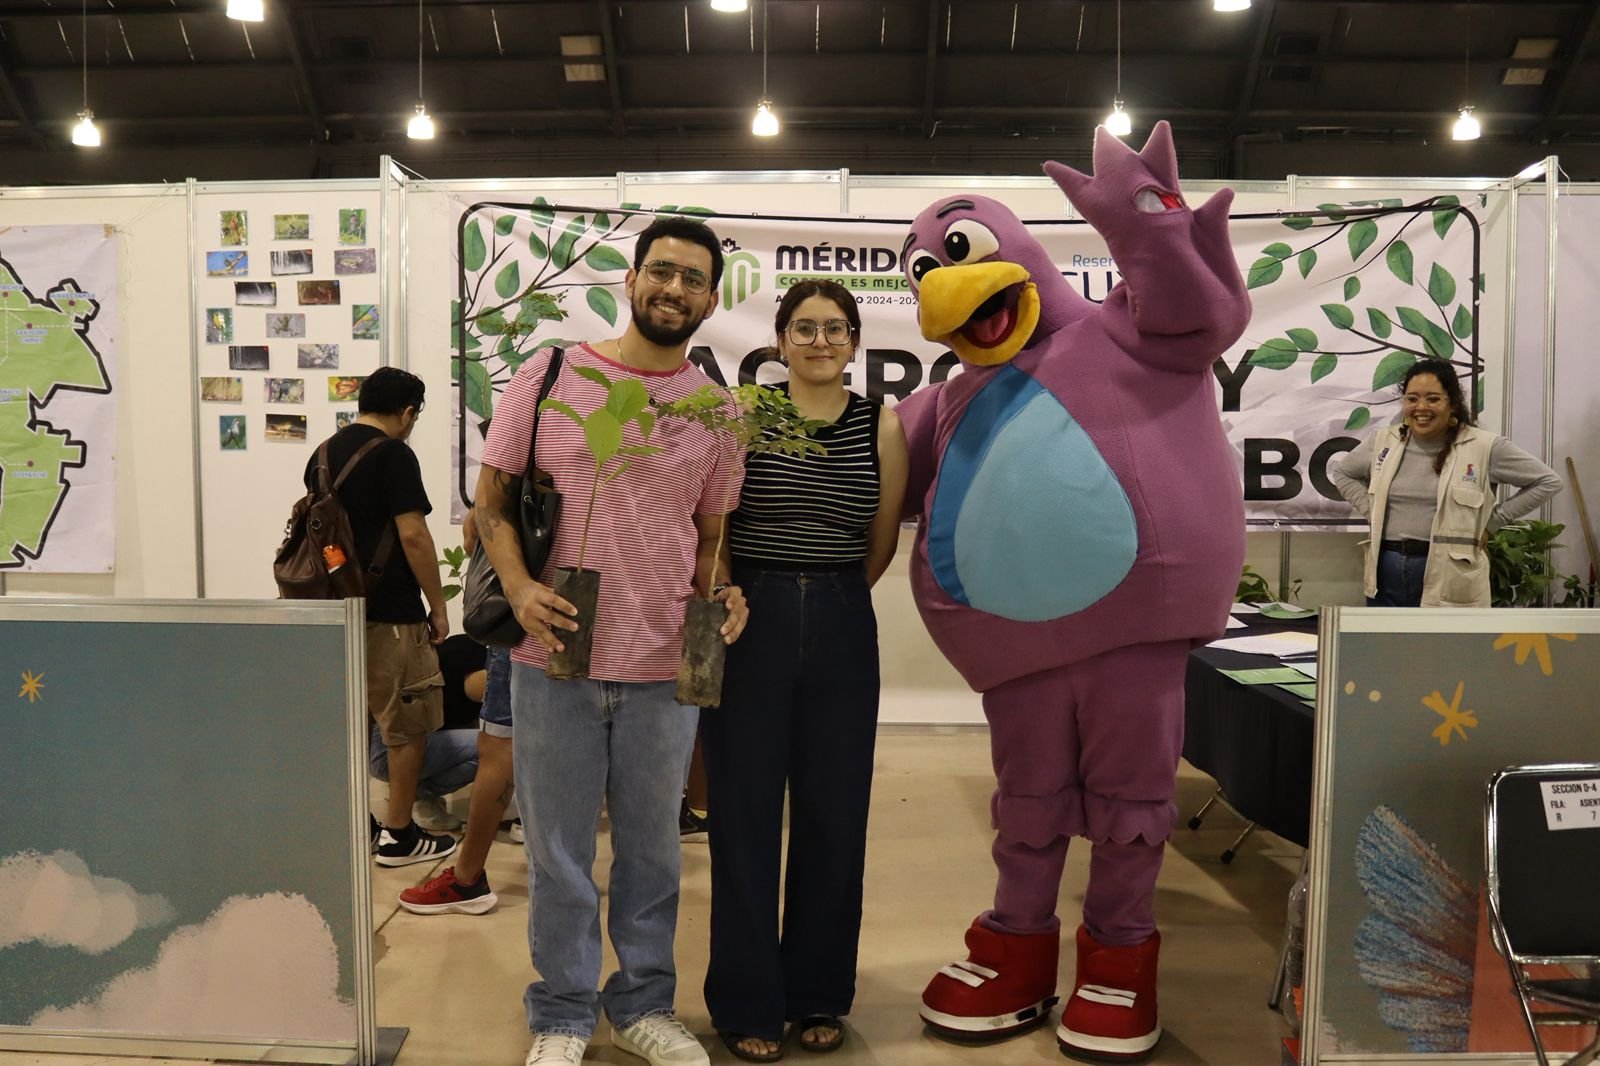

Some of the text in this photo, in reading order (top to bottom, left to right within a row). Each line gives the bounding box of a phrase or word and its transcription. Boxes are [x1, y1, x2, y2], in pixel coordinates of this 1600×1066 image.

[776, 242, 905, 272] MÉRID
[1072, 254, 1114, 267] Reser
[851, 279, 867, 287] ES
[873, 279, 908, 290] MEJO
[866, 296, 919, 305] 2024-202
[1552, 783, 1597, 794] SECCION D-4
[1580, 799, 1600, 807] ASIENT
[1591, 810, 1596, 820] 7
